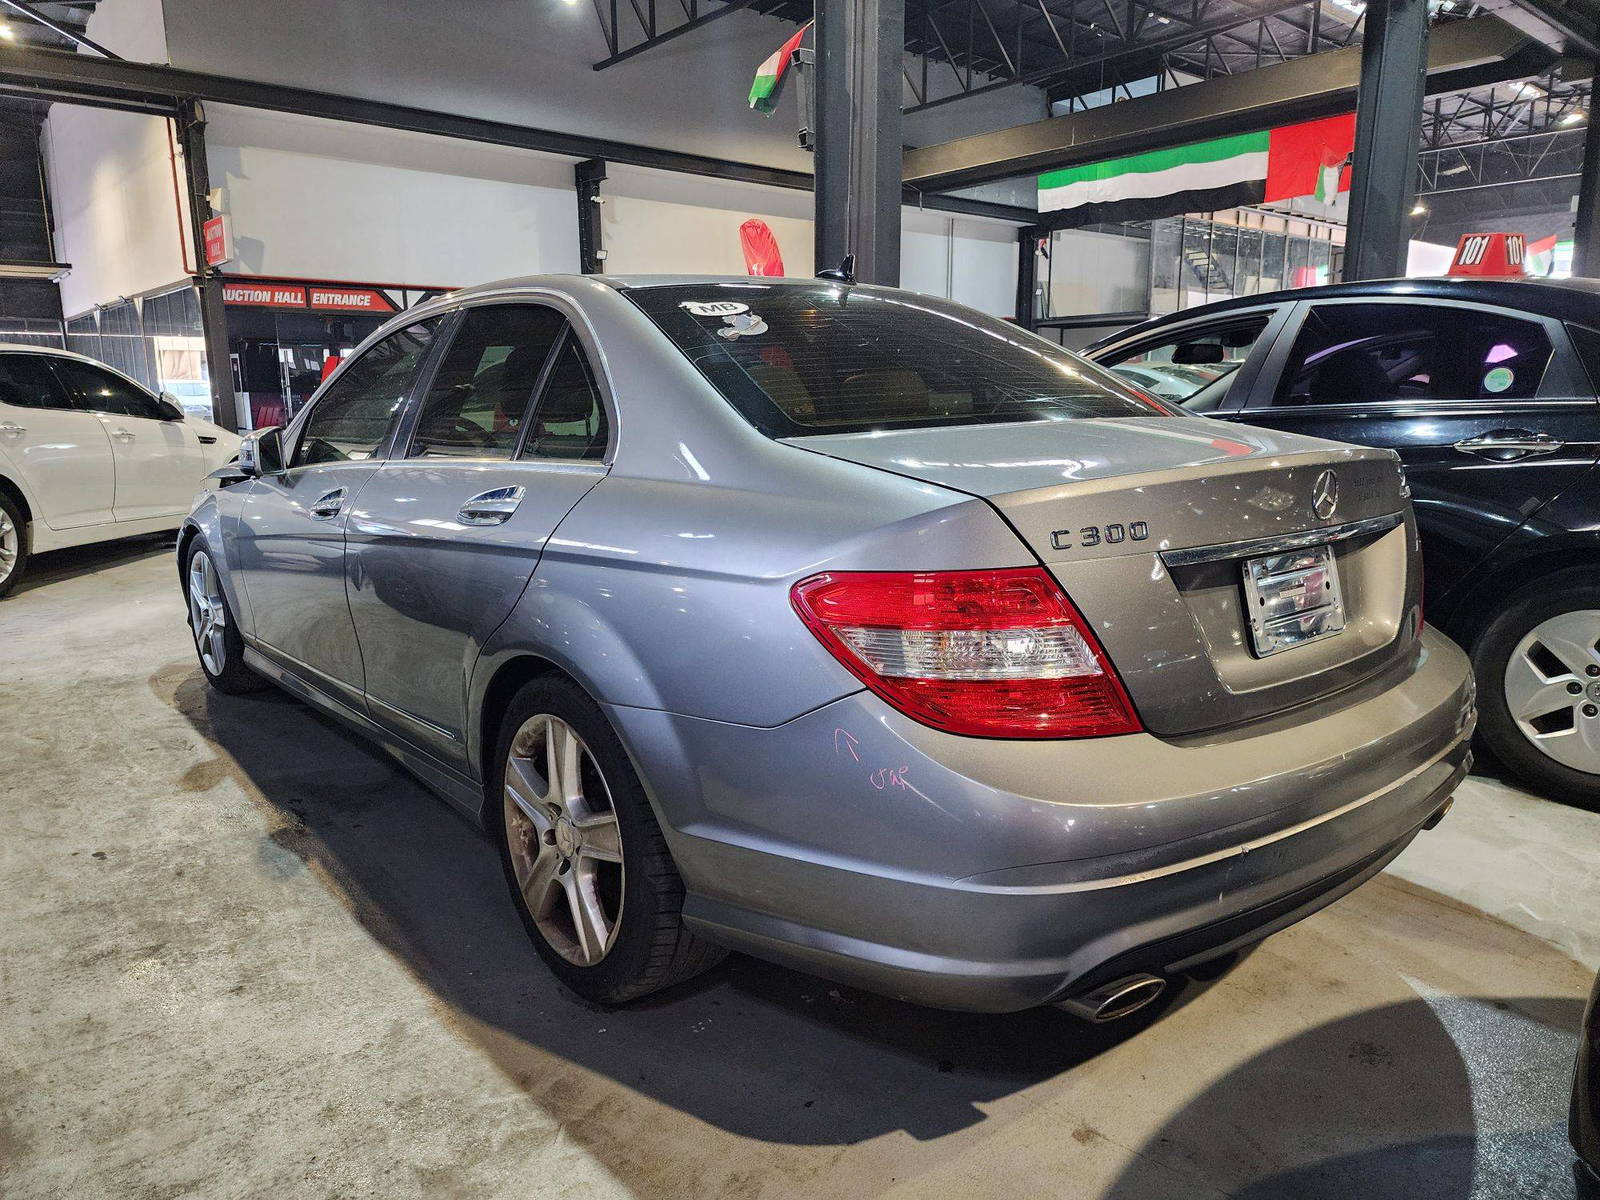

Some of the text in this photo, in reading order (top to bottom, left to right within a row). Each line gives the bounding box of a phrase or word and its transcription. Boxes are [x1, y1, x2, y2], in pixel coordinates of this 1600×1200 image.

[1458, 236, 1490, 265] 101
[1507, 236, 1525, 265] 101
[274, 291, 304, 304] HALL
[312, 293, 371, 306] ENTRANCE
[700, 303, 738, 314] MB
[1049, 520, 1150, 551] C 300
